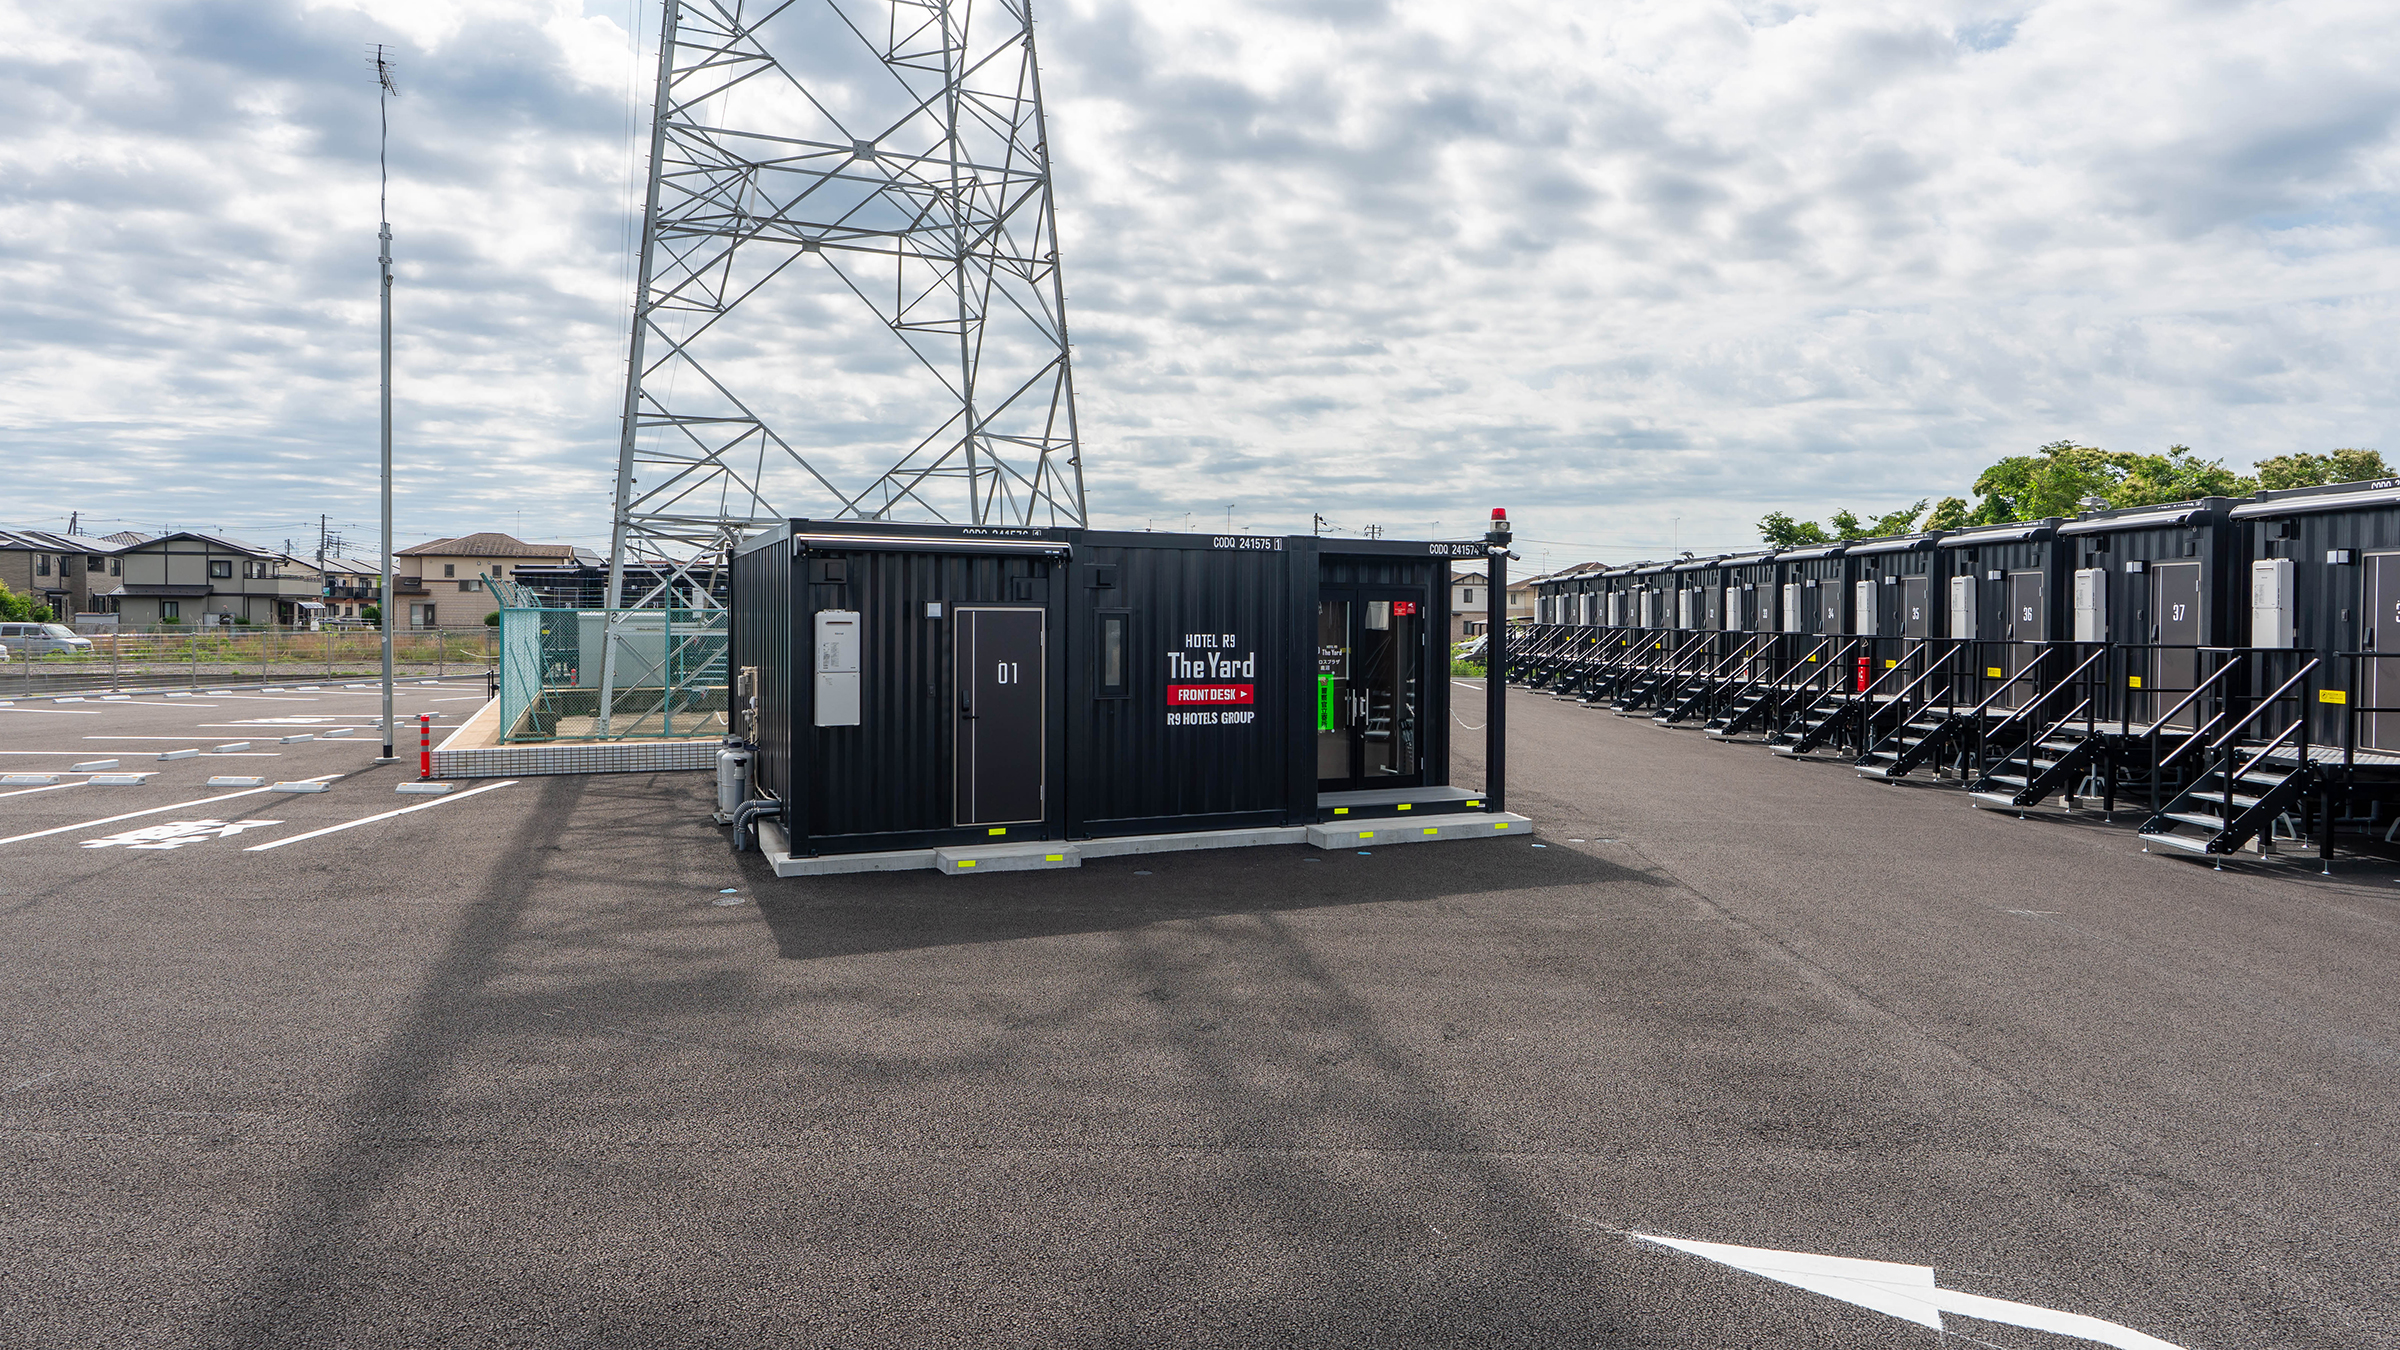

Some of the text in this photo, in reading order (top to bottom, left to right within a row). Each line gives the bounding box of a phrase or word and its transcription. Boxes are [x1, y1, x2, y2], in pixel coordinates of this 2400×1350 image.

[1213, 536, 1236, 548] CODQ
[1240, 537, 1271, 549] 241575
[1429, 543, 1449, 555] CODQ
[1912, 607, 1920, 620] 35
[2022, 606, 2033, 622] 36
[2172, 604, 2186, 621] 37
[1185, 633, 1236, 648] HOTEL R9
[1167, 651, 1255, 679] The Yard
[998, 662, 1018, 684] 01
[1178, 688, 1236, 701] FRONT DESK
[1167, 711, 1255, 726] R9 HOTELS GROUP
